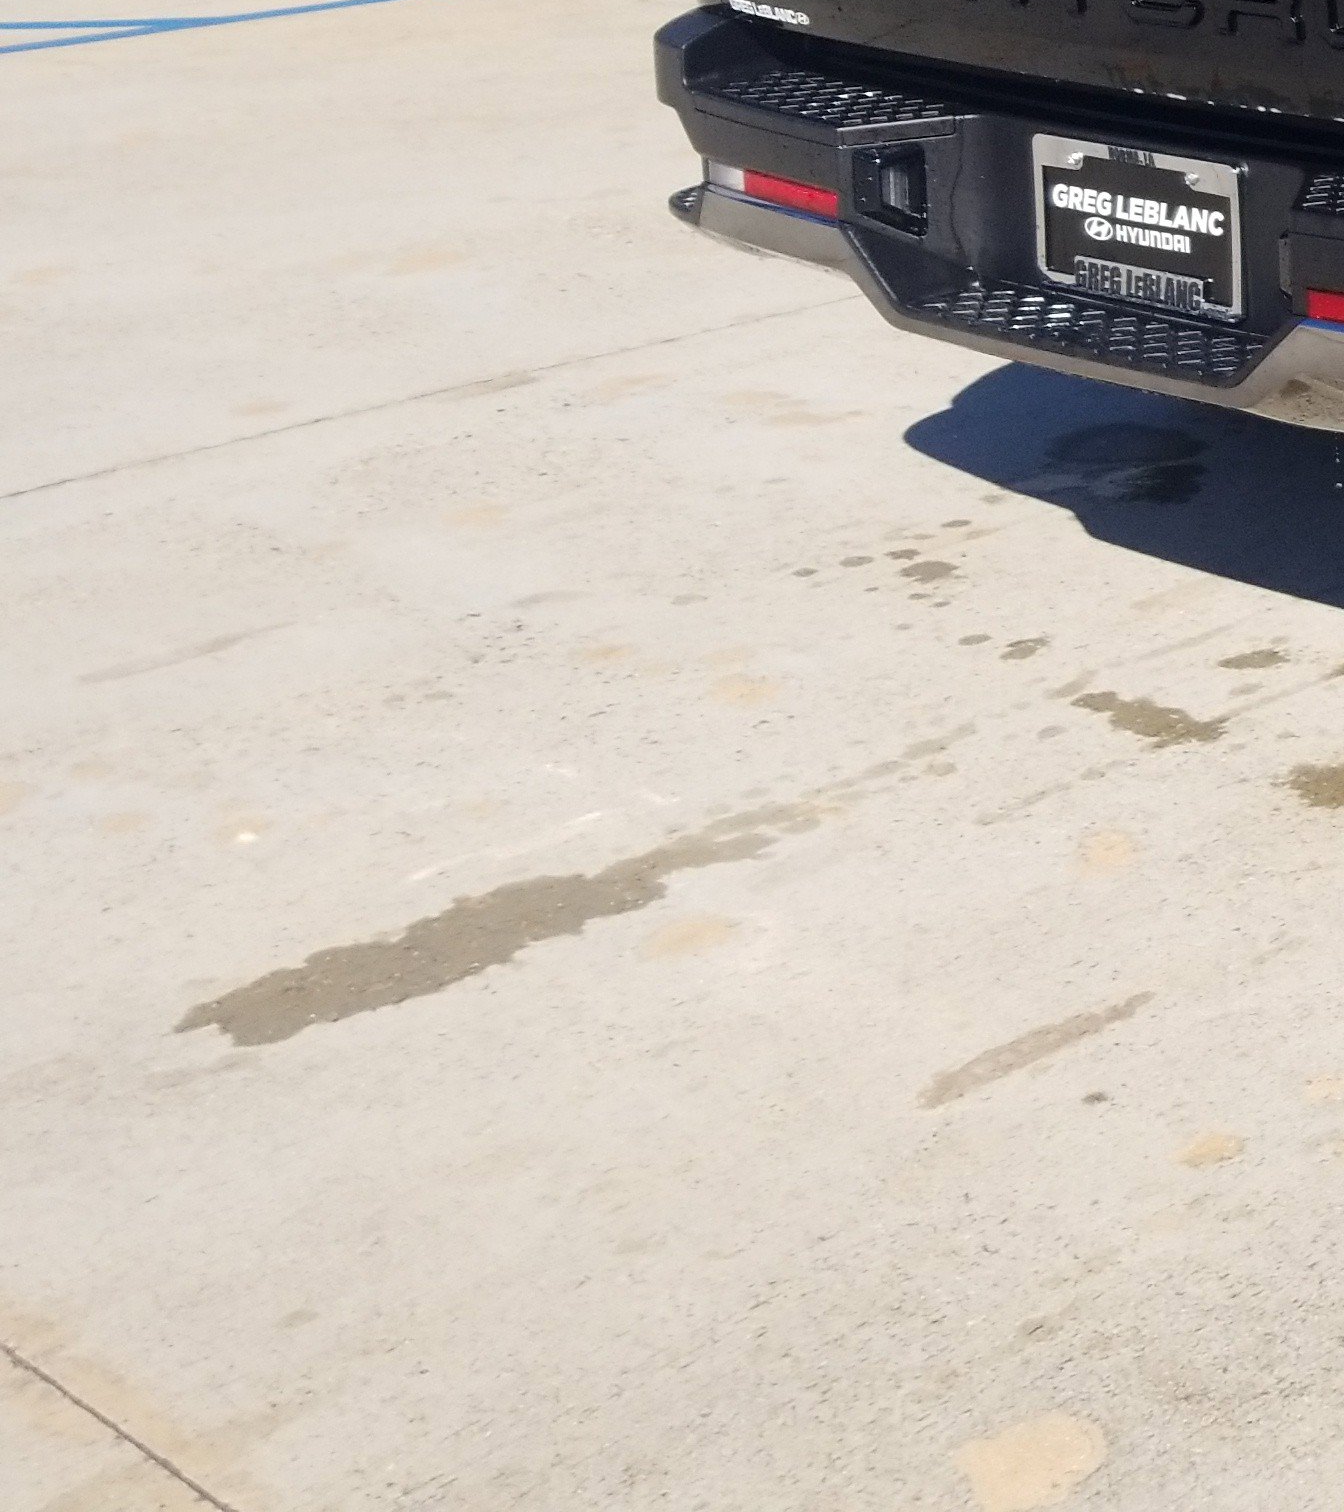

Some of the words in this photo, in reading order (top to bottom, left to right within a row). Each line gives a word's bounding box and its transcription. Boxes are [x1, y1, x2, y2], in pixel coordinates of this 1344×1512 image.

[1052, 183, 1112, 216] GREG
[1116, 194, 1225, 237] LEBLANC
[1116, 224, 1192, 254] HYUNDAI
[1075, 259, 1121, 295] GREG
